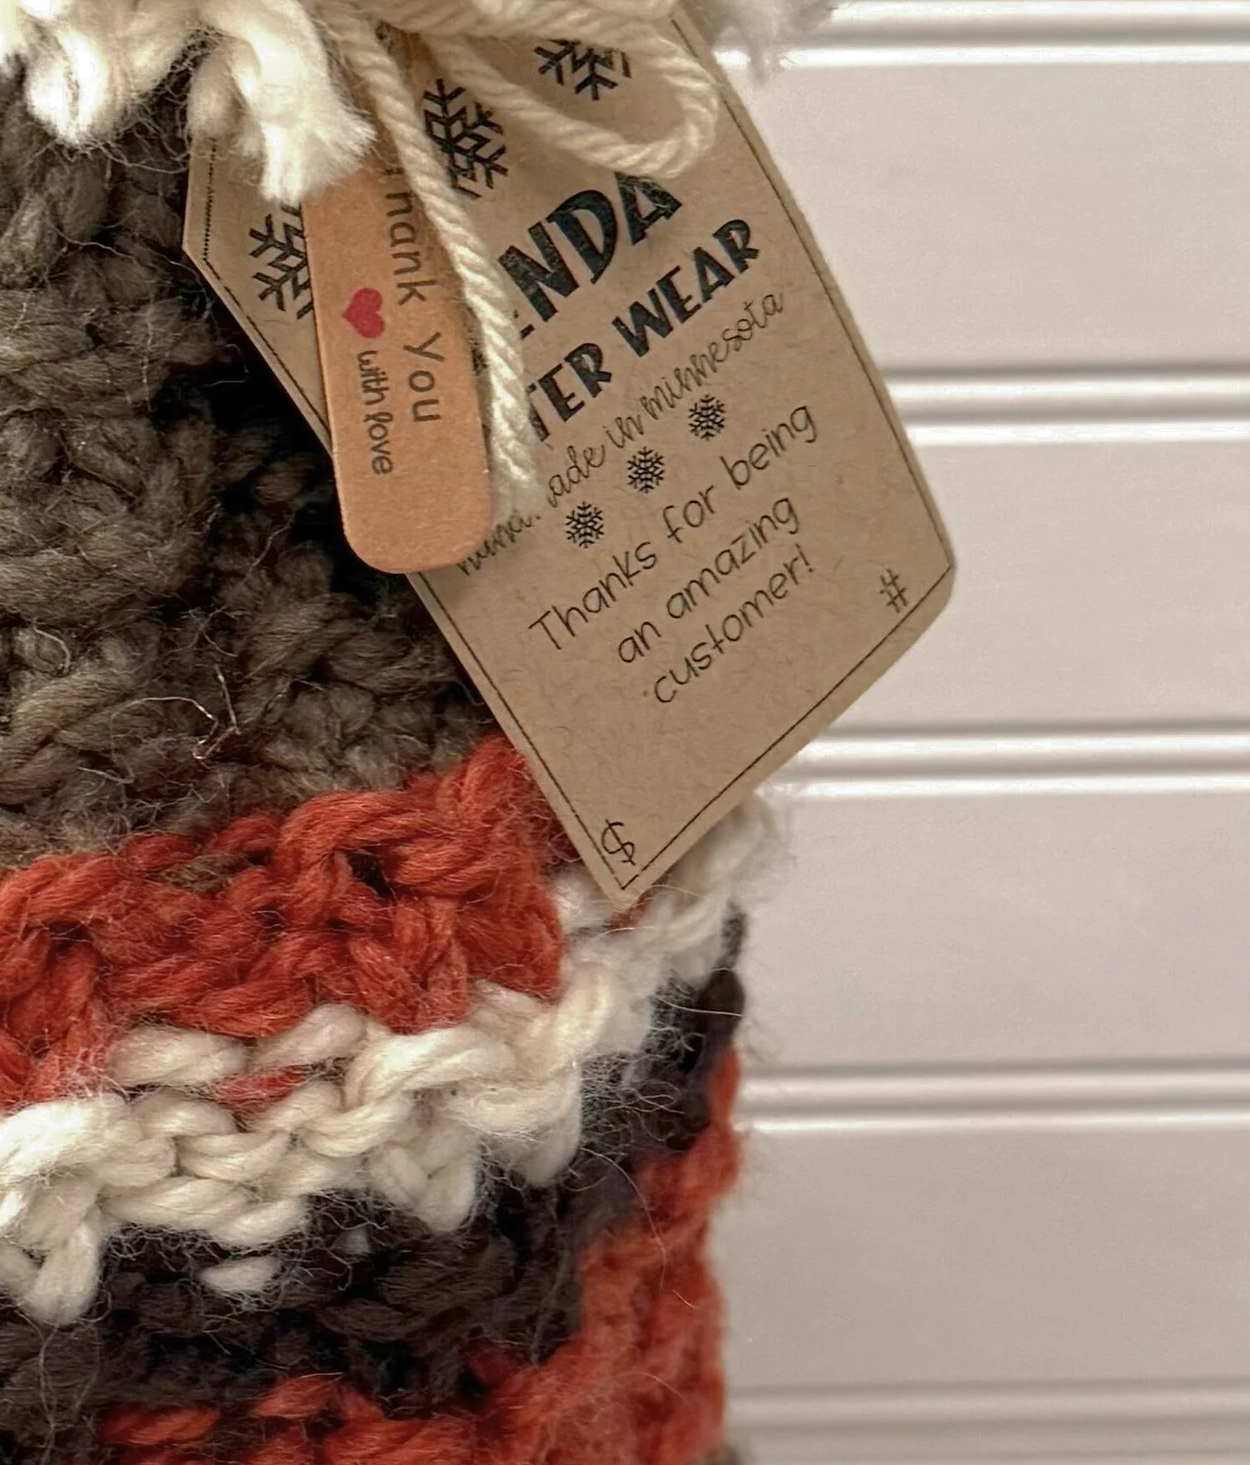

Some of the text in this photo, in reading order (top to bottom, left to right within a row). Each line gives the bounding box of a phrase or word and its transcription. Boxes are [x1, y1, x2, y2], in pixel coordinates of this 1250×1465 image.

[497, 171, 683, 339] NDA
[523, 219, 760, 442] TER WEAR
[357, 349, 394, 475] with love
[403, 332, 445, 423] You
[604, 414, 645, 450] in
[640, 292, 784, 421] minnesota
[527, 405, 818, 651] Thanks for being
[617, 496, 800, 664] an amazing
[653, 543, 815, 704] customer!
[600, 818, 636, 867] $
